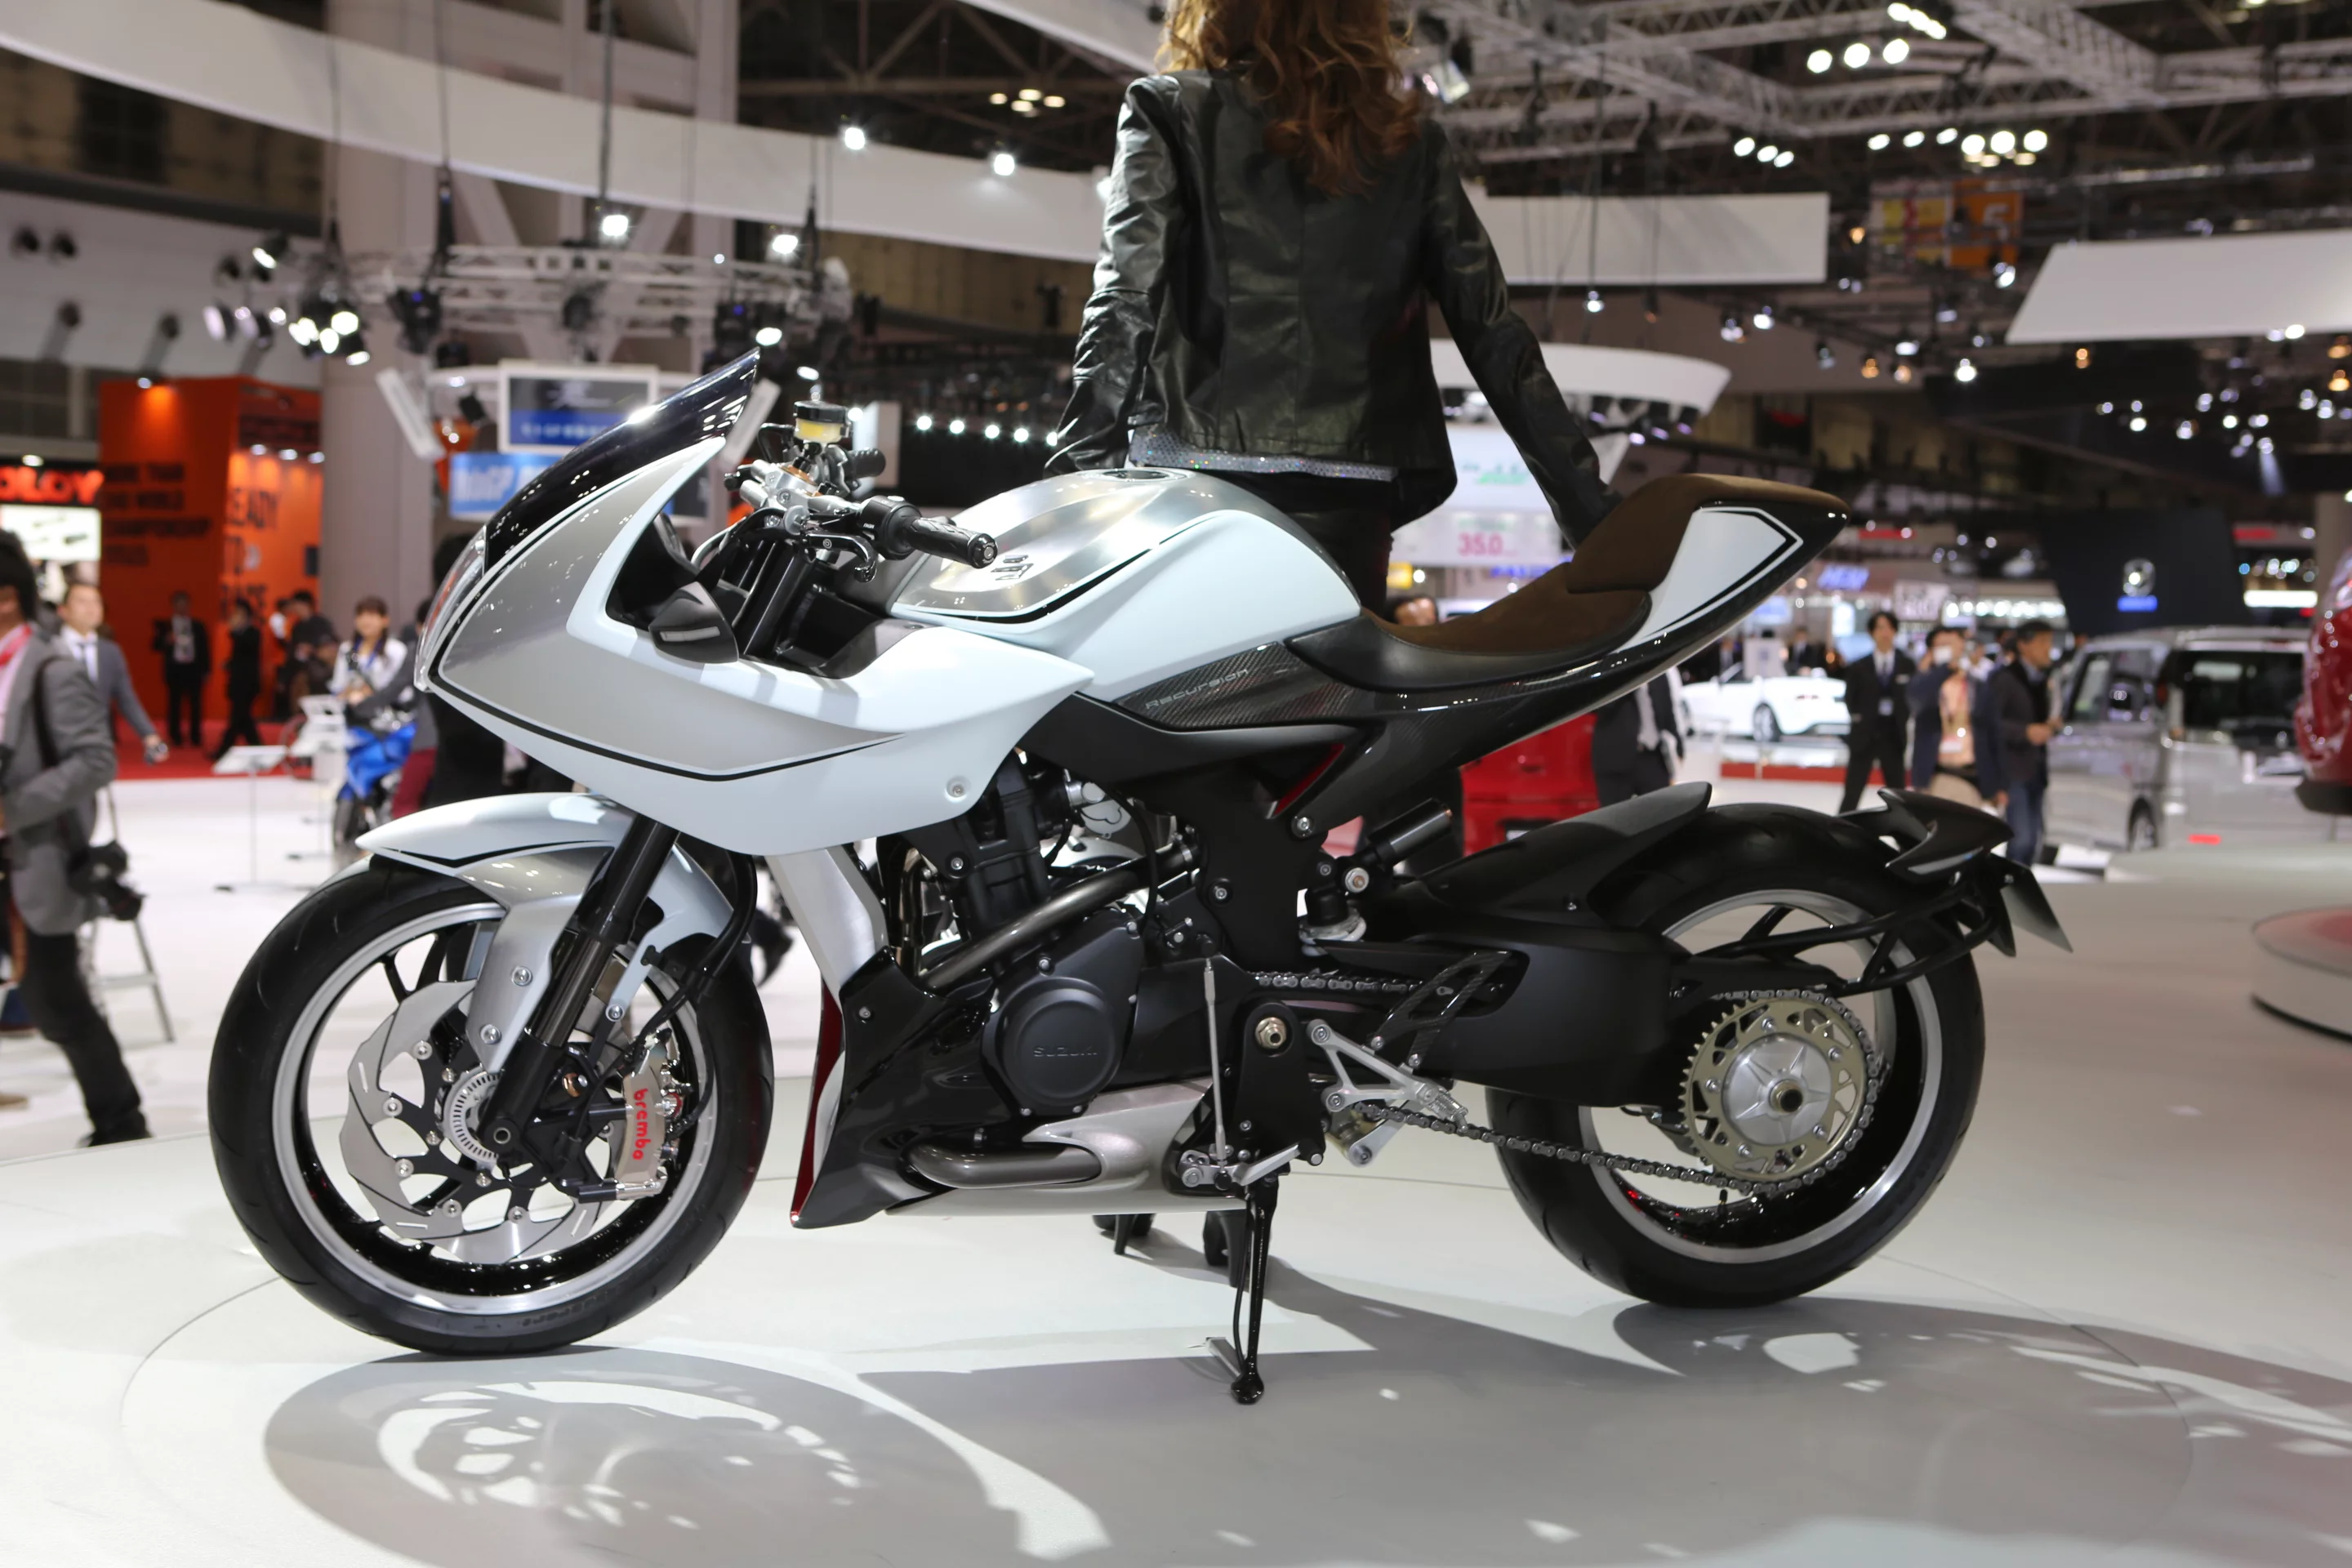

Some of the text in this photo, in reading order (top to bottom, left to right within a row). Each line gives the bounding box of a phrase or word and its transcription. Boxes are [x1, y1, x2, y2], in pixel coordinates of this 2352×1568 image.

[1145, 668, 1249, 710] Recursion
[1033, 1046, 1098, 1058] SUZUKI
[632, 1087, 652, 1160] brembo
